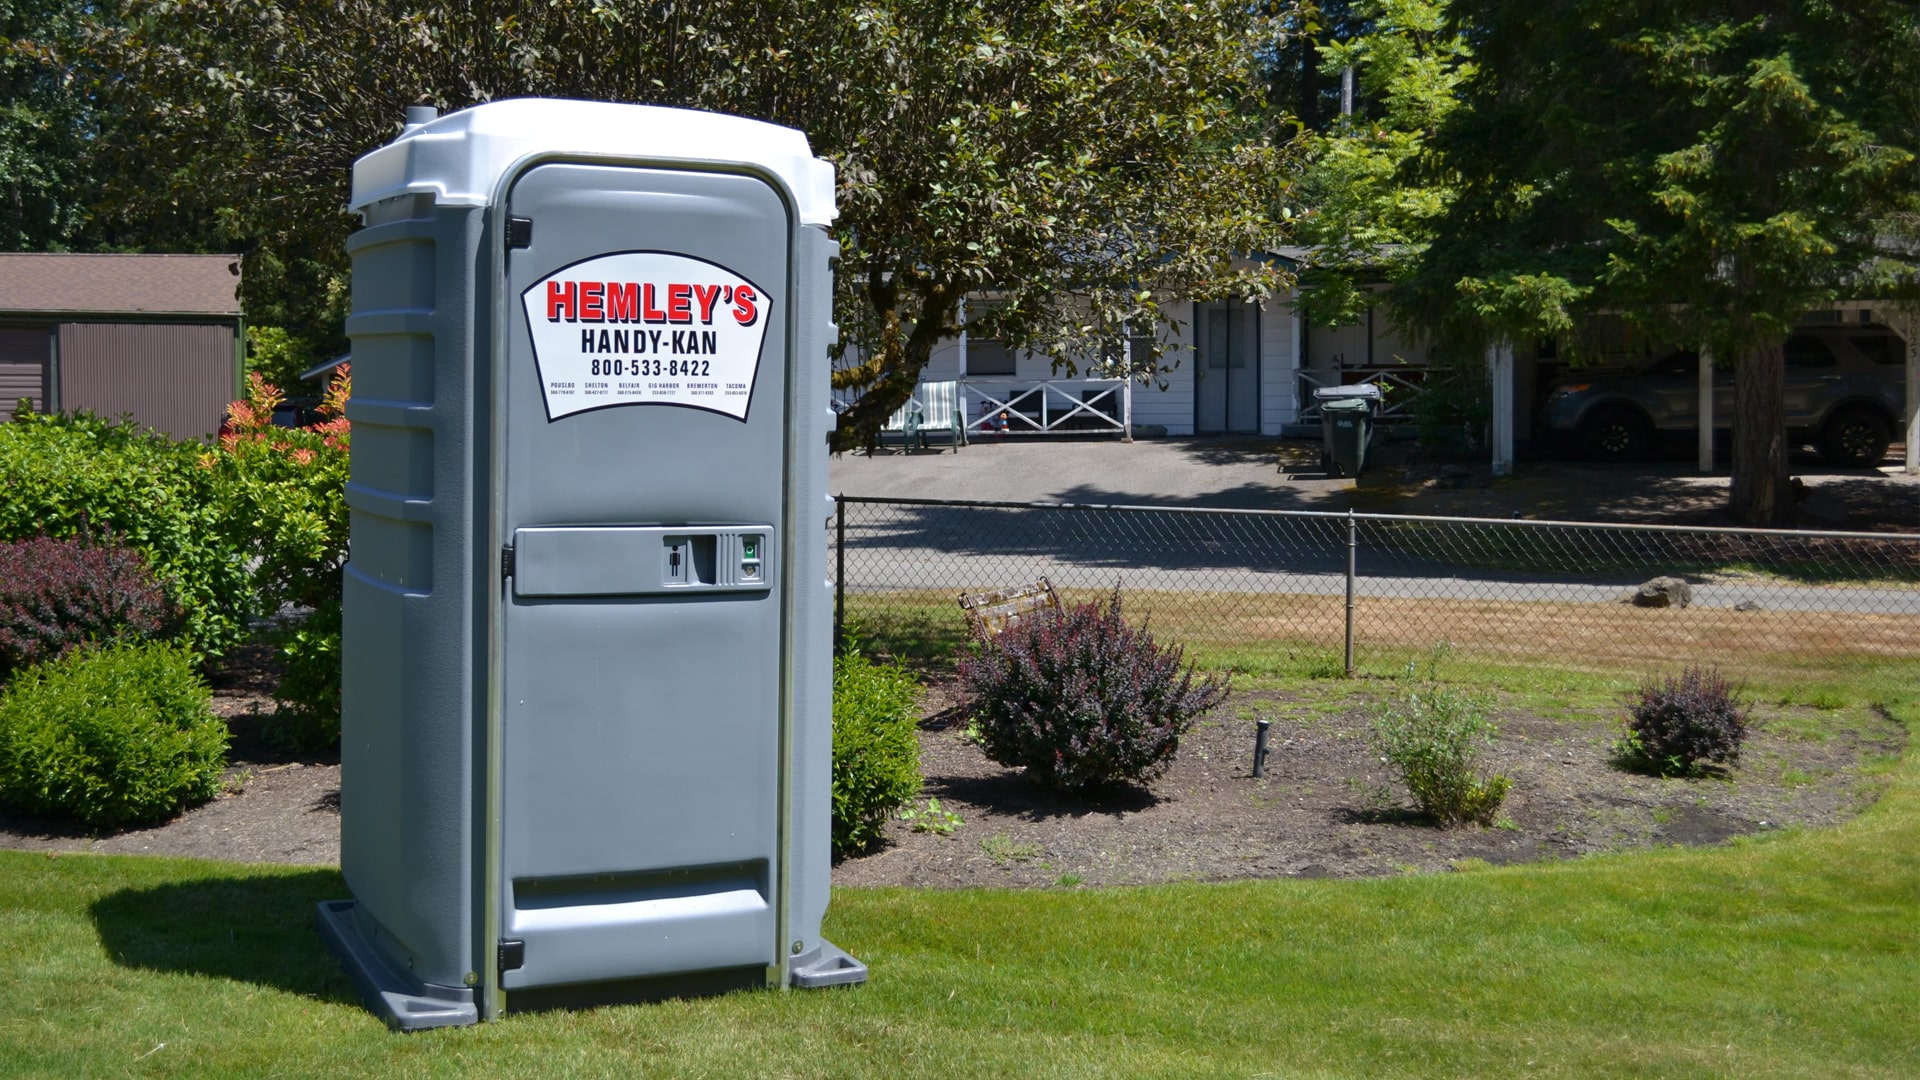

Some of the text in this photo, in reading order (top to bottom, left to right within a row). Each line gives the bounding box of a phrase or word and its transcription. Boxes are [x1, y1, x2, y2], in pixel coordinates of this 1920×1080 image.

[547, 281, 758, 327] HEMLEY'S
[581, 329, 717, 355] HANDY-KAN
[591, 359, 710, 376] 800-533-8422
